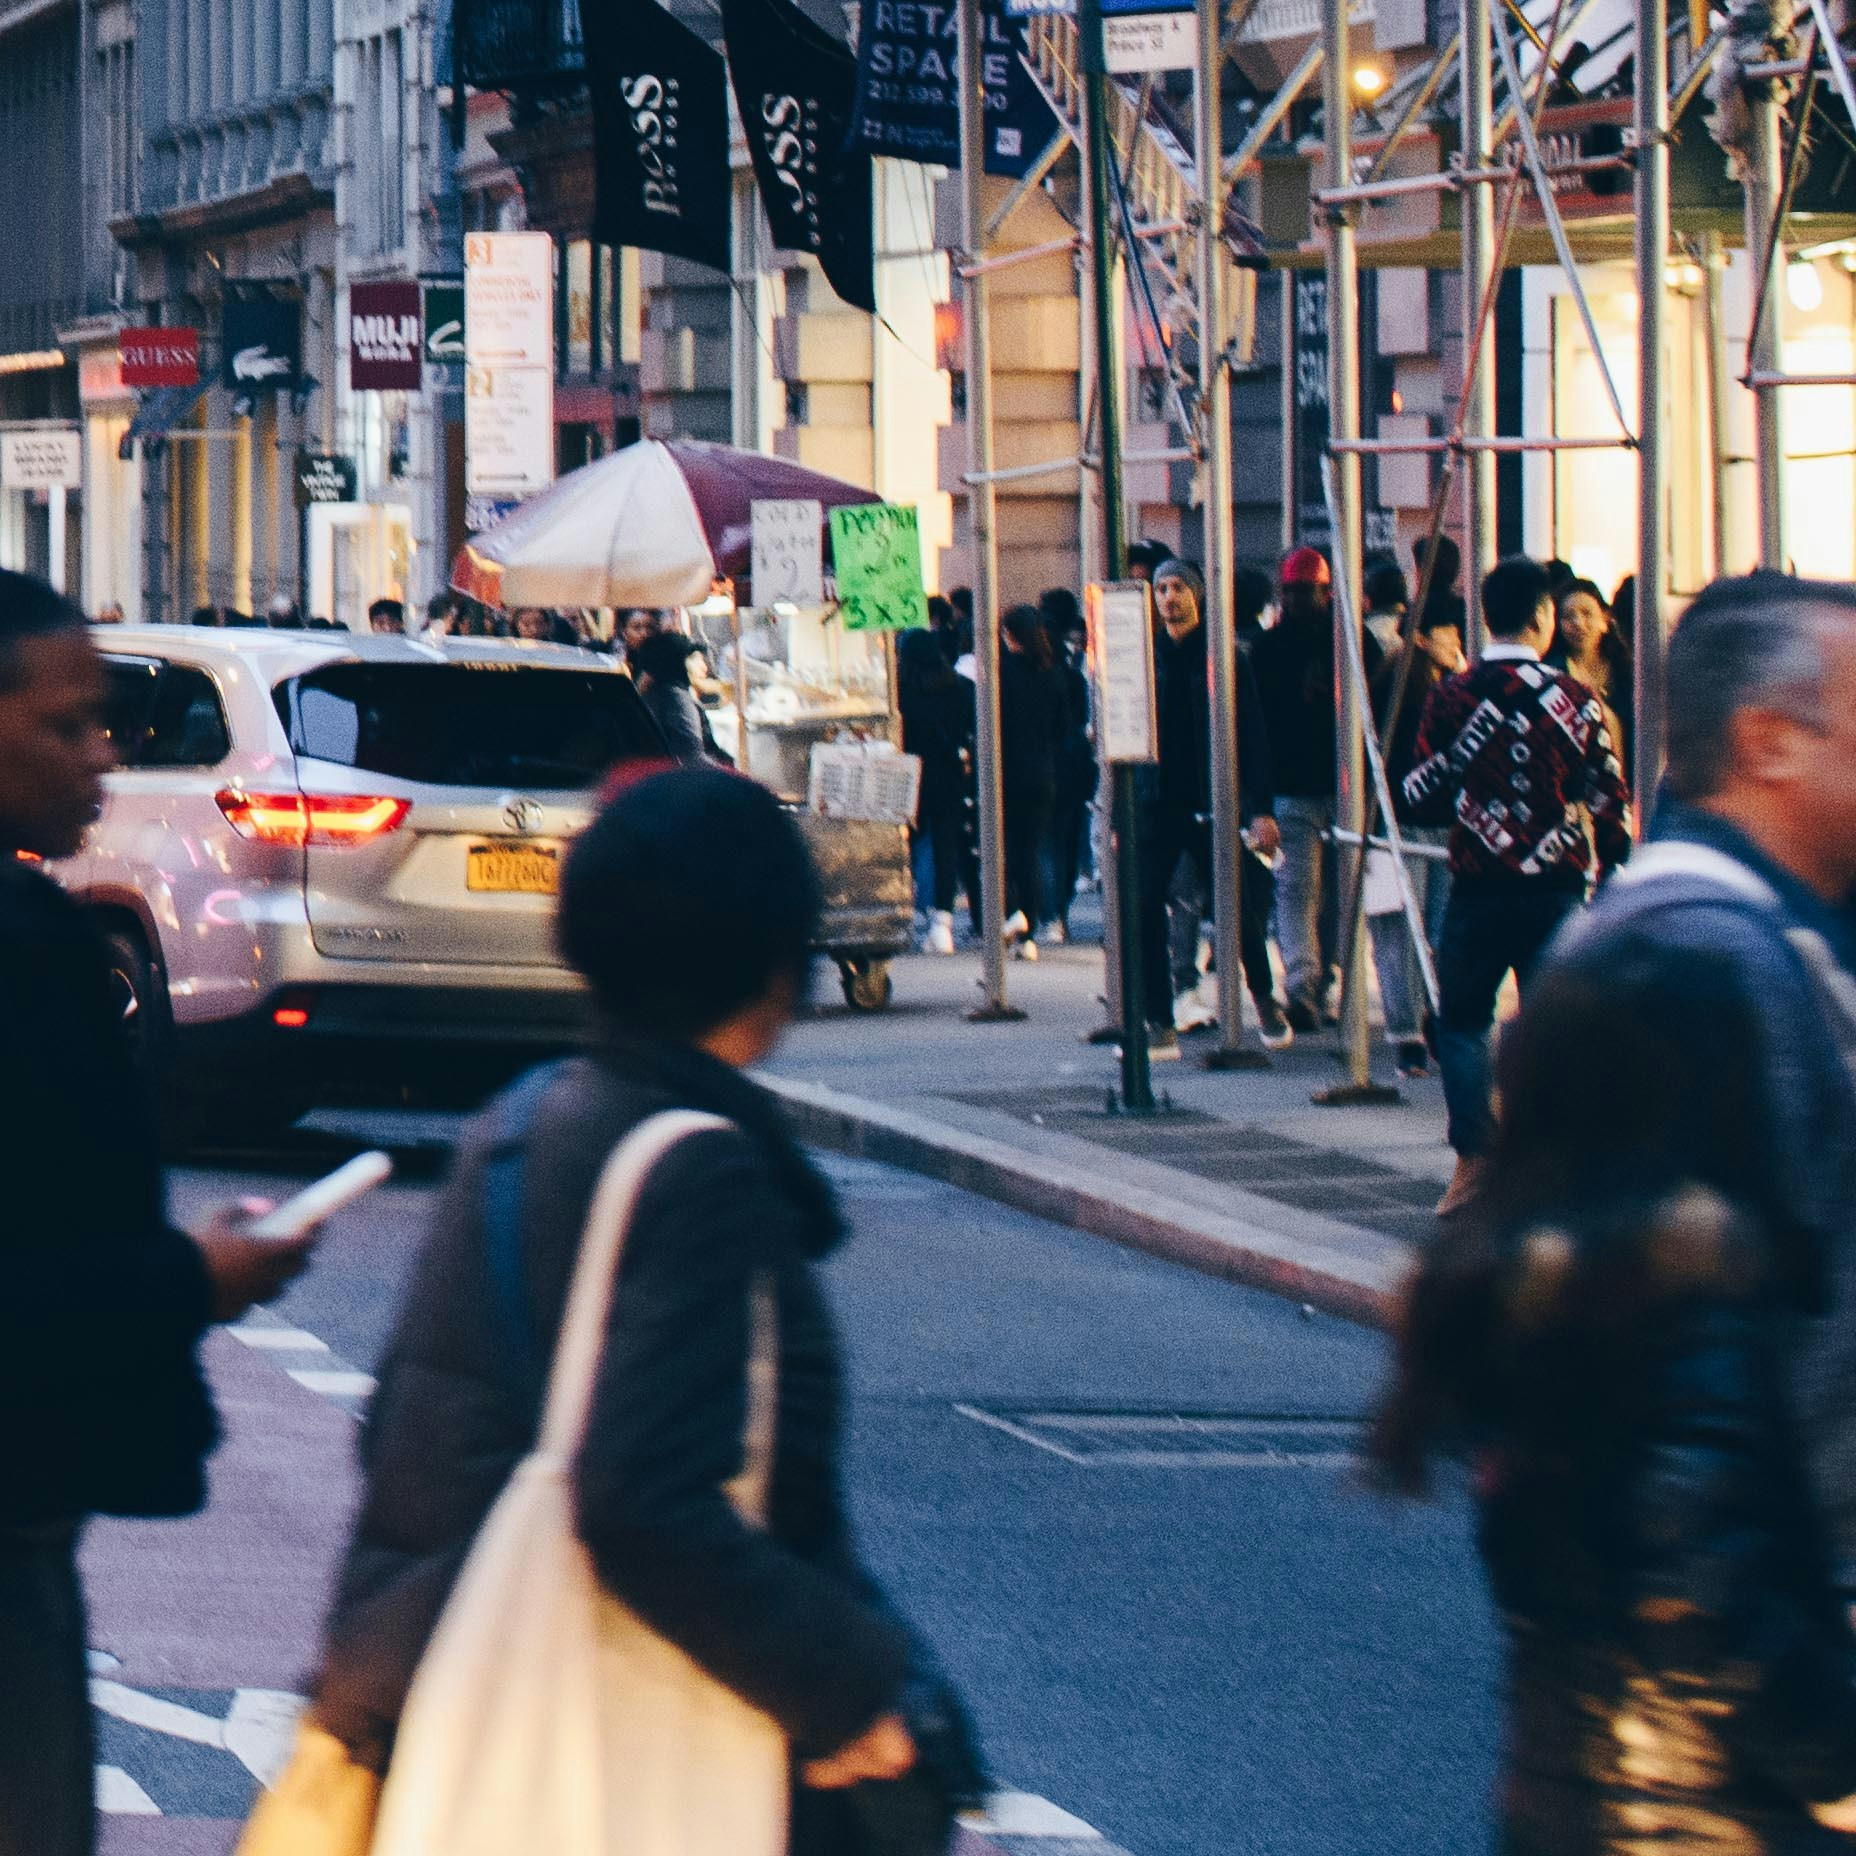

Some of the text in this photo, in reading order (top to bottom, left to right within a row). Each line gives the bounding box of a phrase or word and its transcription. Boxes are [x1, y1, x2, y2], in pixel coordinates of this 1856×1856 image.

[869, 44, 1009, 86] SPAE
[353, 315, 419, 345] MUJI
[120, 346, 197, 367] GUESS
